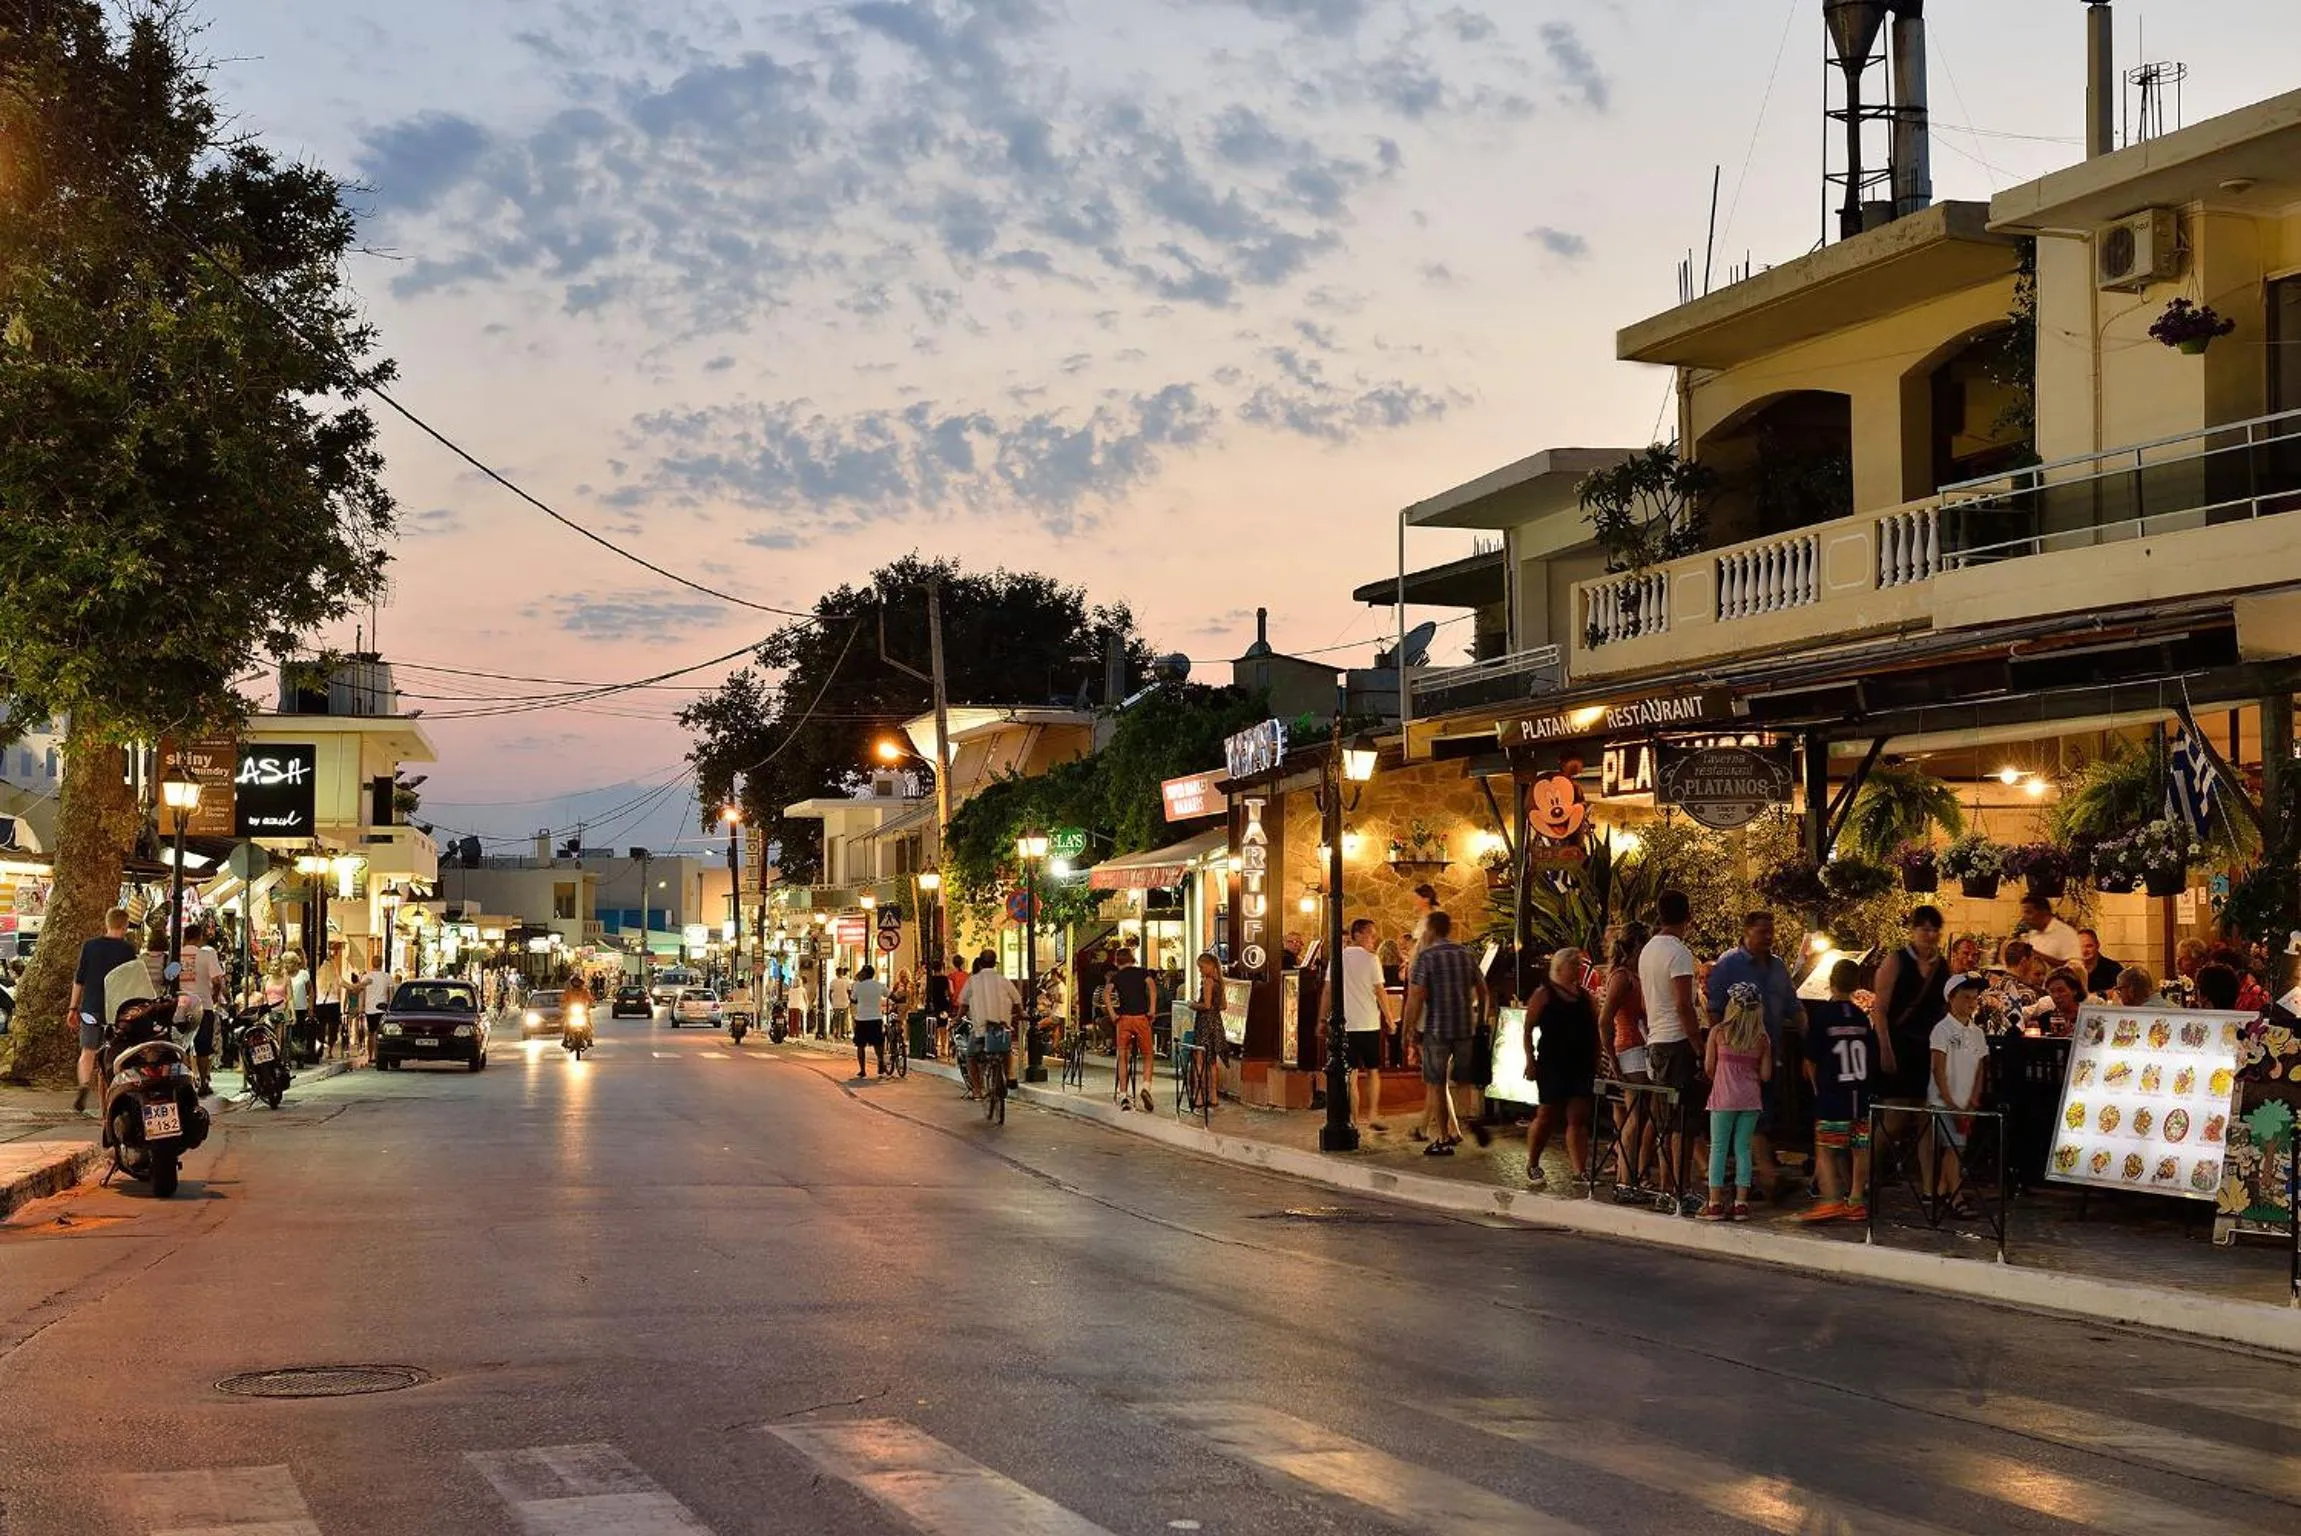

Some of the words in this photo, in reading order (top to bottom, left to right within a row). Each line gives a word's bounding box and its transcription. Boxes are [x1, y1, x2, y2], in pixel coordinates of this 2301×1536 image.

[1606, 696, 1703, 729] RESTAURANT
[1685, 779, 1768, 796] PLATANOS
[1242, 798, 1268, 969] TARTUFO
[1831, 1039, 1867, 1081] 10
[157, 1119, 179, 1131] 182
